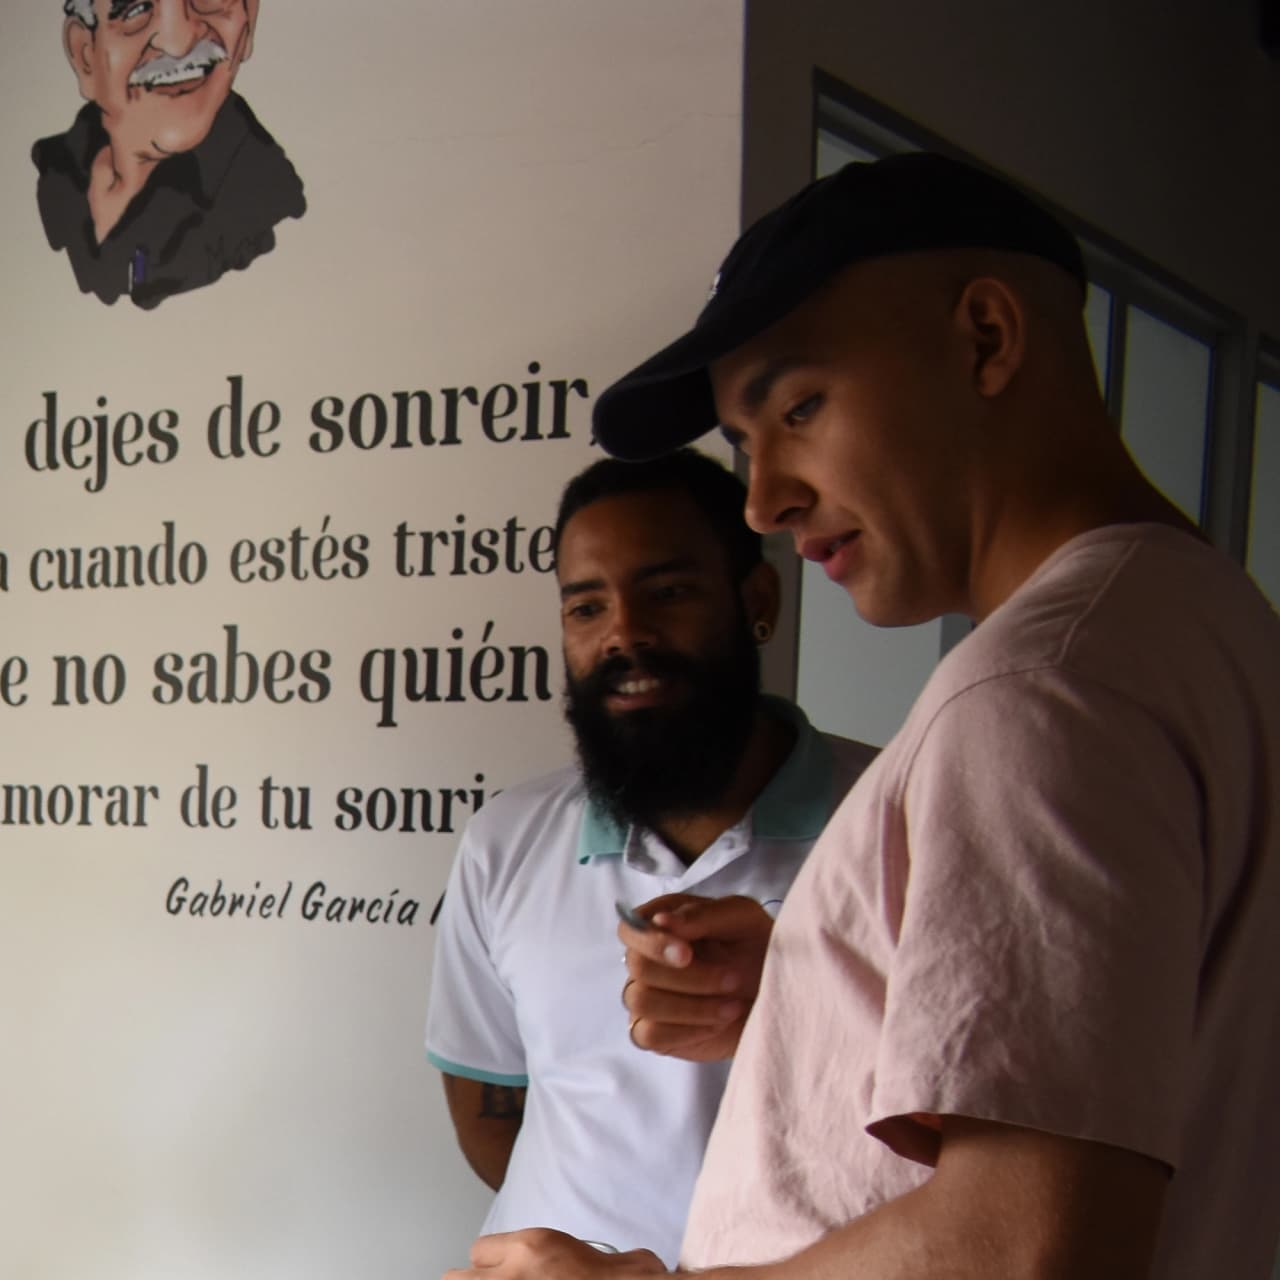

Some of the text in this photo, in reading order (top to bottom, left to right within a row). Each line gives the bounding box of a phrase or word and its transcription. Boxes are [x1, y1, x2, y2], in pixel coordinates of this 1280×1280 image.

[25, 391, 179, 493] dejes
[208, 374, 281, 459] de
[30, 521, 208, 592] cuando
[230, 515, 370, 584] estés
[394, 514, 557, 577] triste
[51, 652, 126, 706] no
[152, 625, 331, 704] sabes
[360, 620, 552, 727] quién
[180, 764, 237, 829] de
[259, 776, 312, 830] tu
[335, 773, 504, 833] sonri
[166, 877, 292, 919] Gabriel
[301, 881, 419, 926] García
